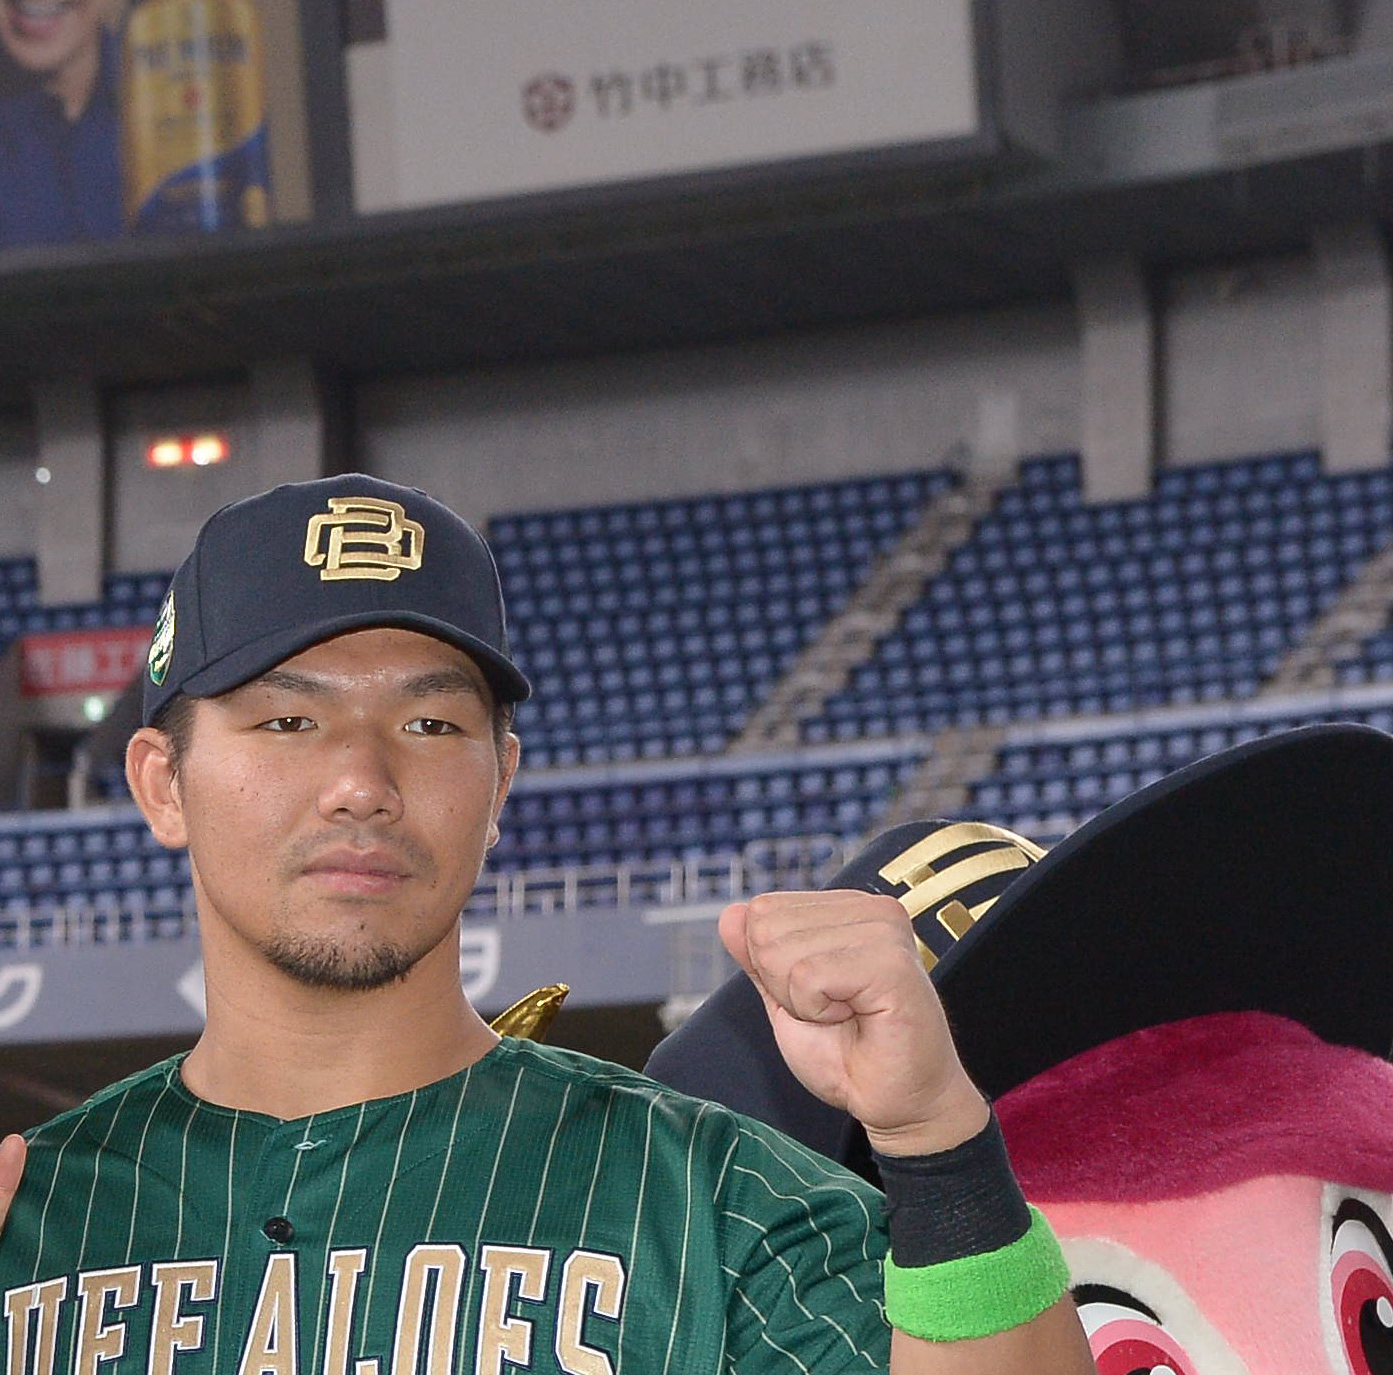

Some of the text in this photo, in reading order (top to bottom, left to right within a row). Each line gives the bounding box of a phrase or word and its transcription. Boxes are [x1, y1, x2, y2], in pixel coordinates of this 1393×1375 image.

[588, 40, 835, 117] 竹中工務店
